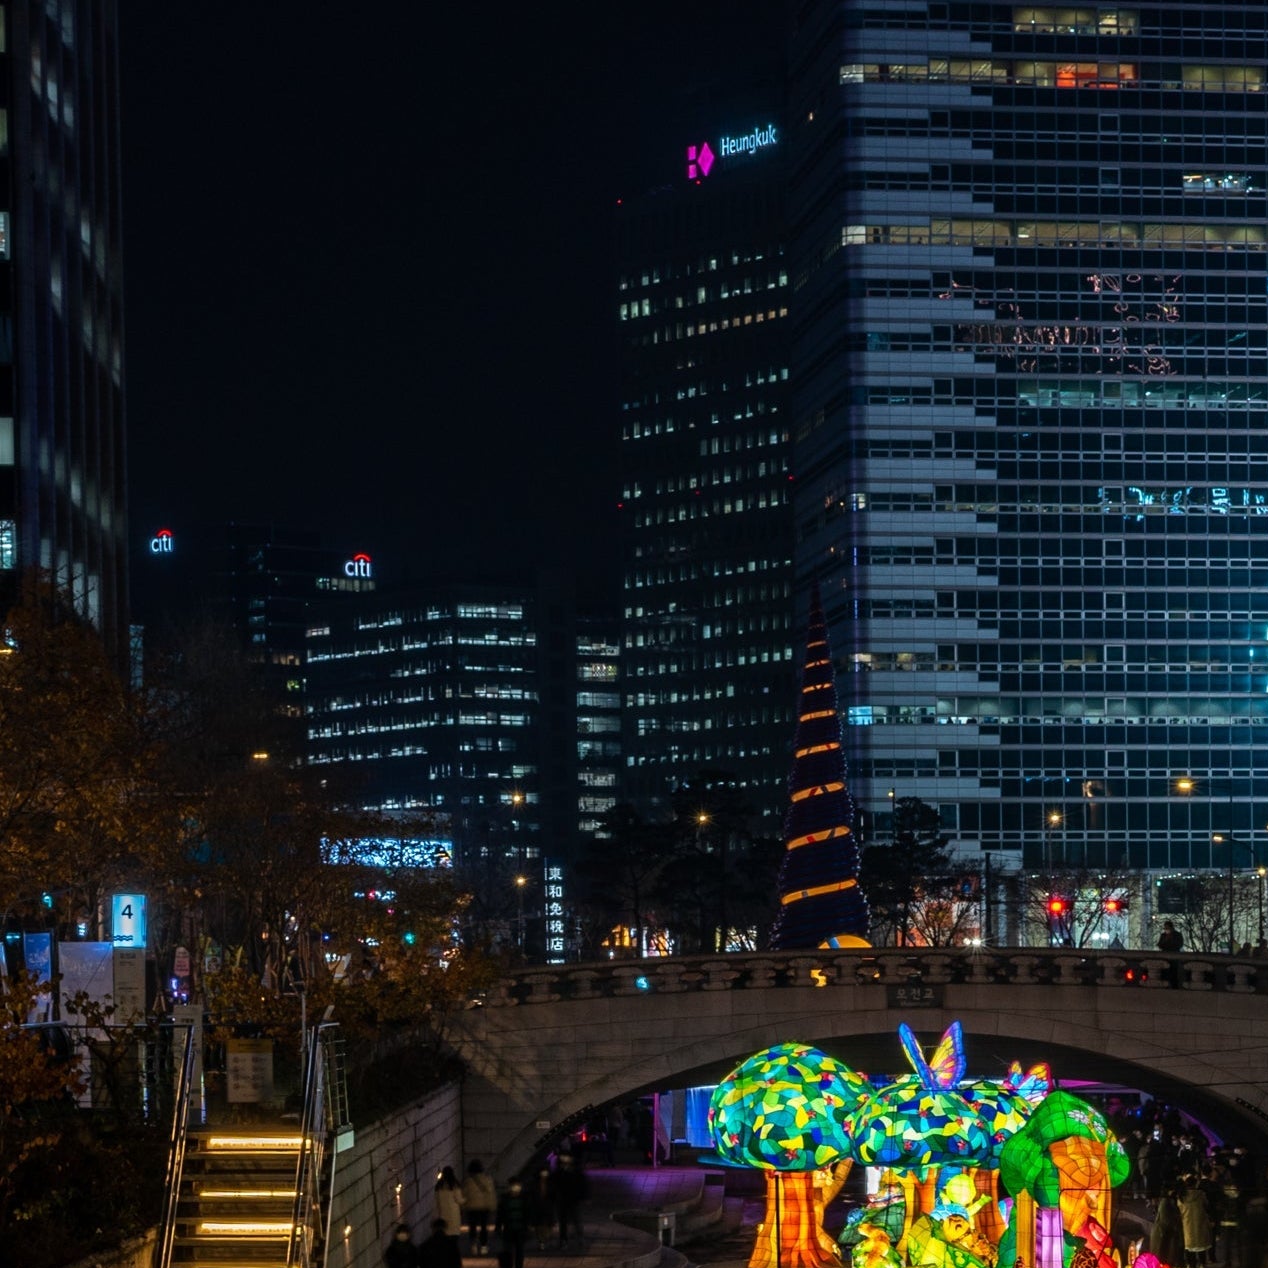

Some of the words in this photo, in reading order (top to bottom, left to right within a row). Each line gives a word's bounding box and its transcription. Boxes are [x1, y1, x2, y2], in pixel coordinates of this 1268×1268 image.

[721, 124, 776, 156] Heungkuk
[151, 534, 172, 552] citi
[345, 558, 371, 577] citi
[121, 904, 133, 919] 4
